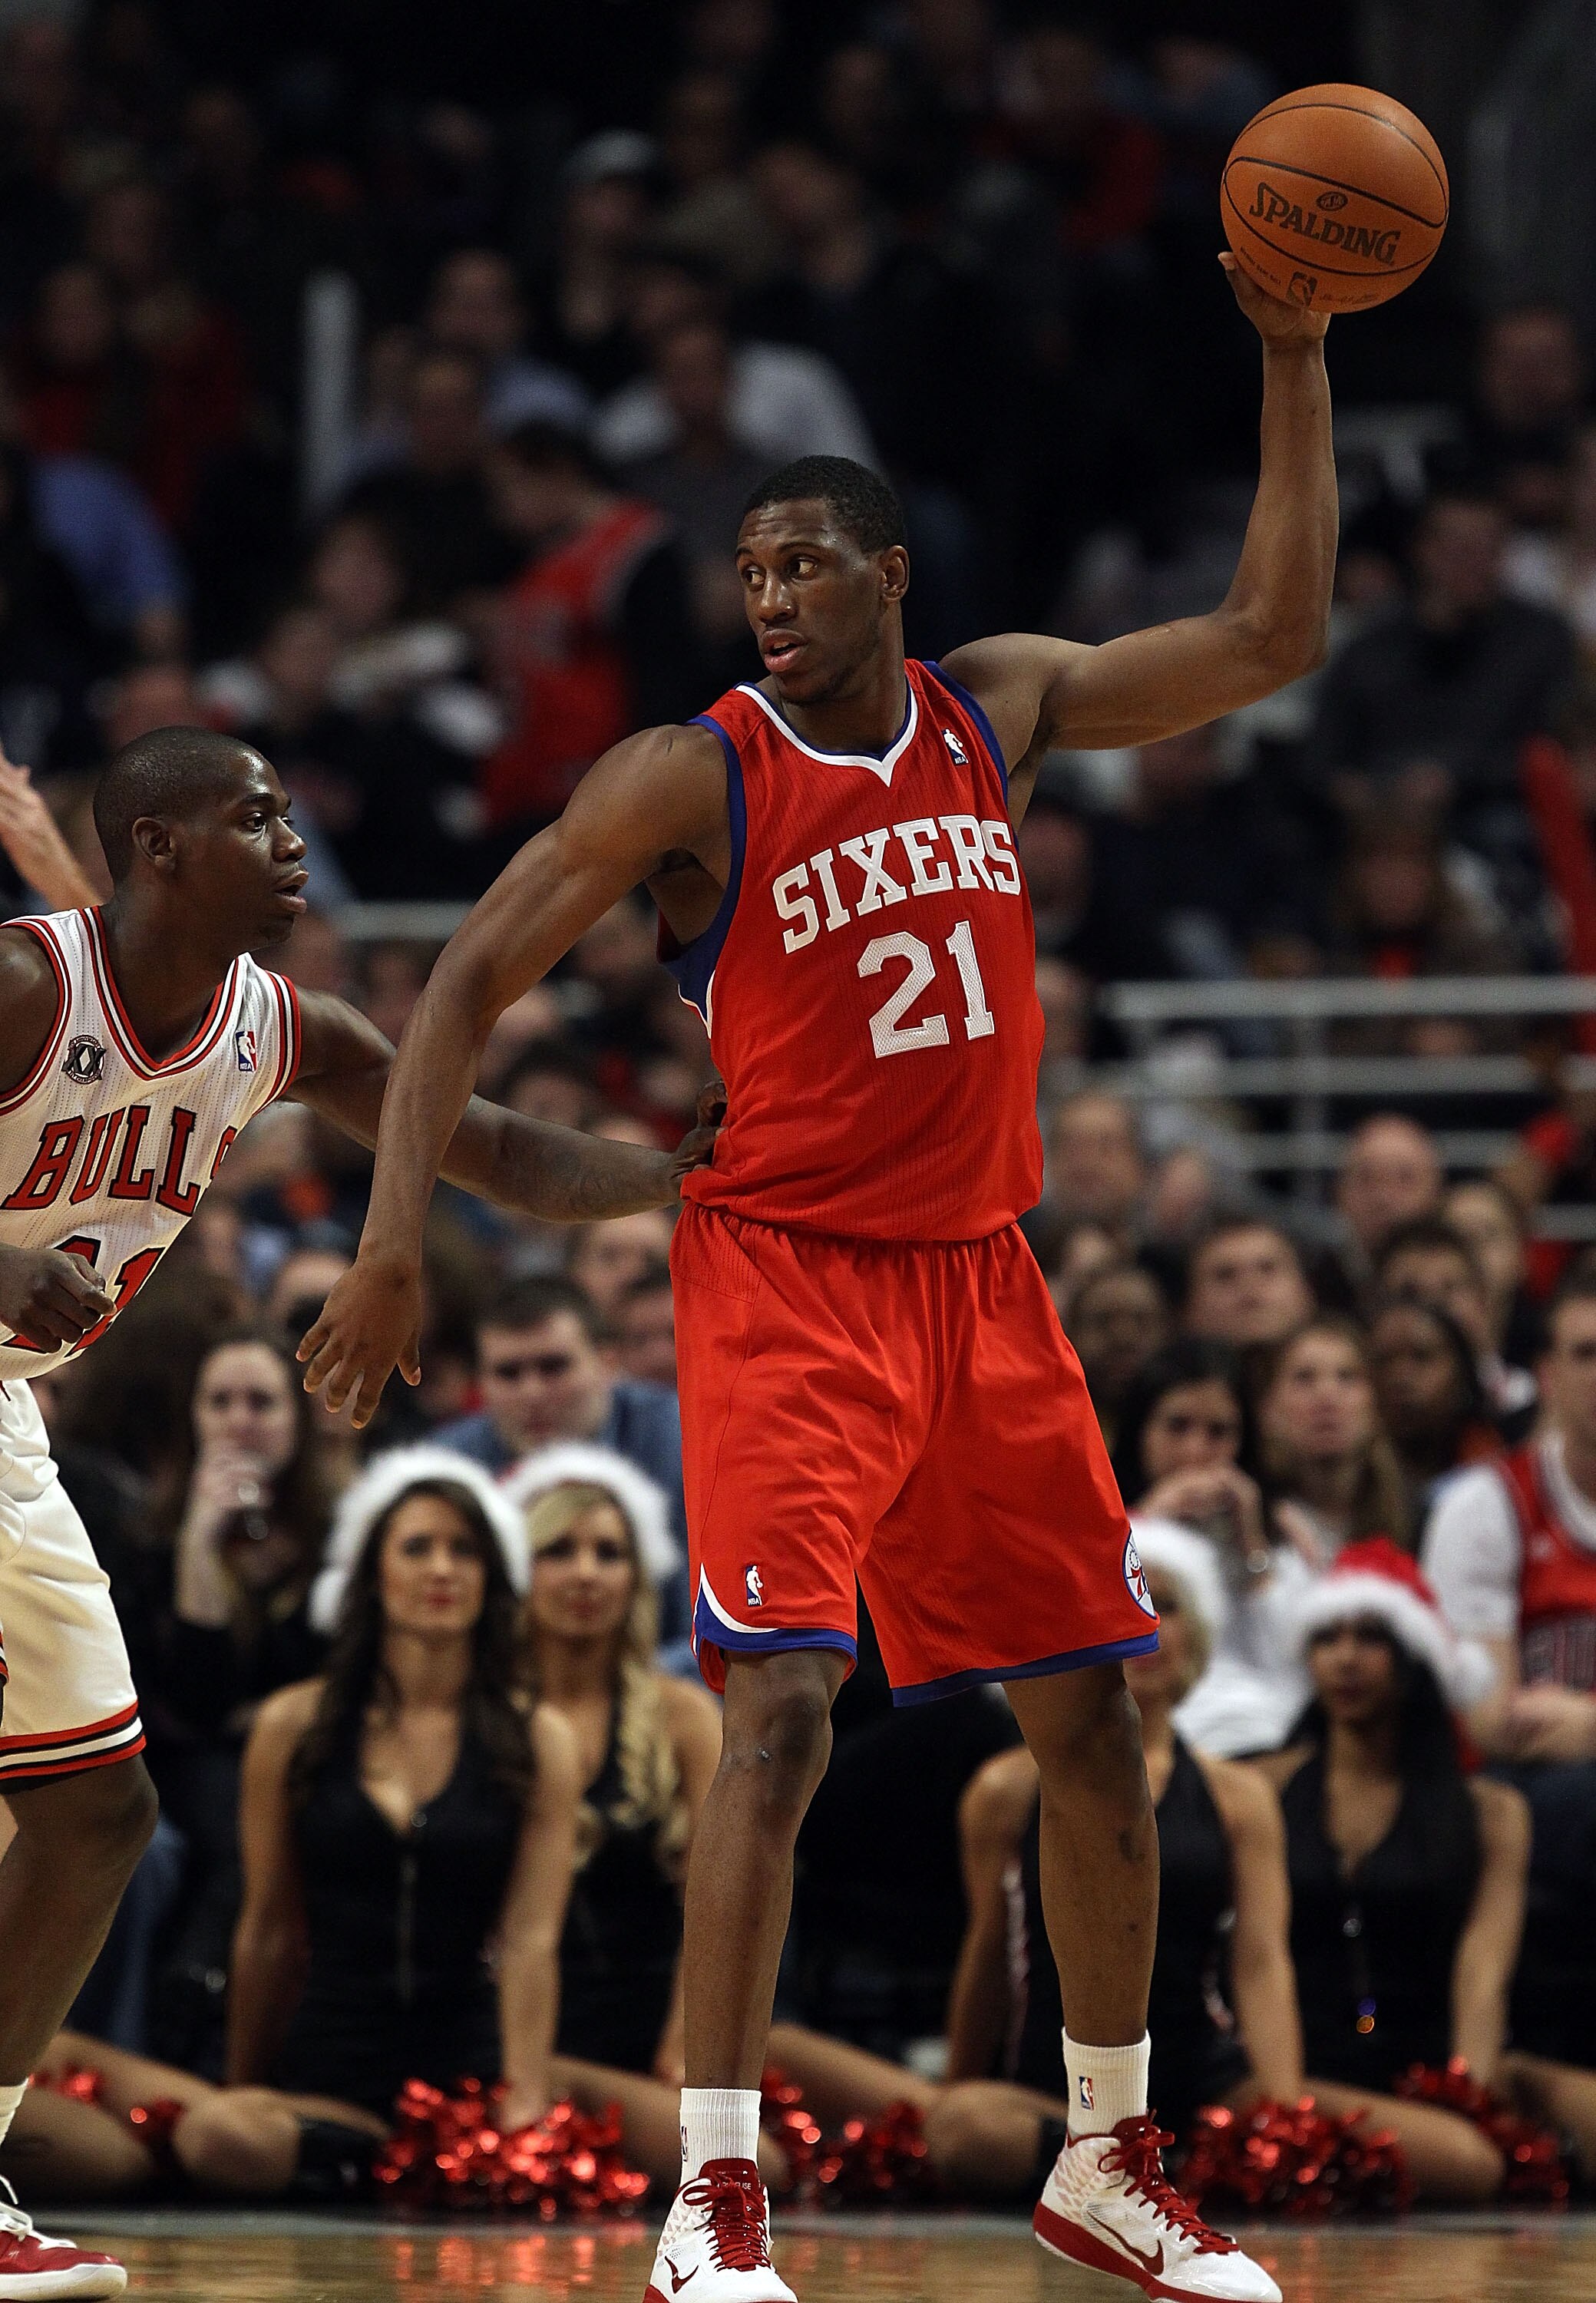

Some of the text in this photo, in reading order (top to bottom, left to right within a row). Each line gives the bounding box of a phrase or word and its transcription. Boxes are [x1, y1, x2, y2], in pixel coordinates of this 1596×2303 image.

[1249, 182, 1401, 266] SPALDING
[772, 814, 1021, 954] SIXERS
[857, 920, 996, 1059] 21
[748, 1598, 760, 1606] NBA
